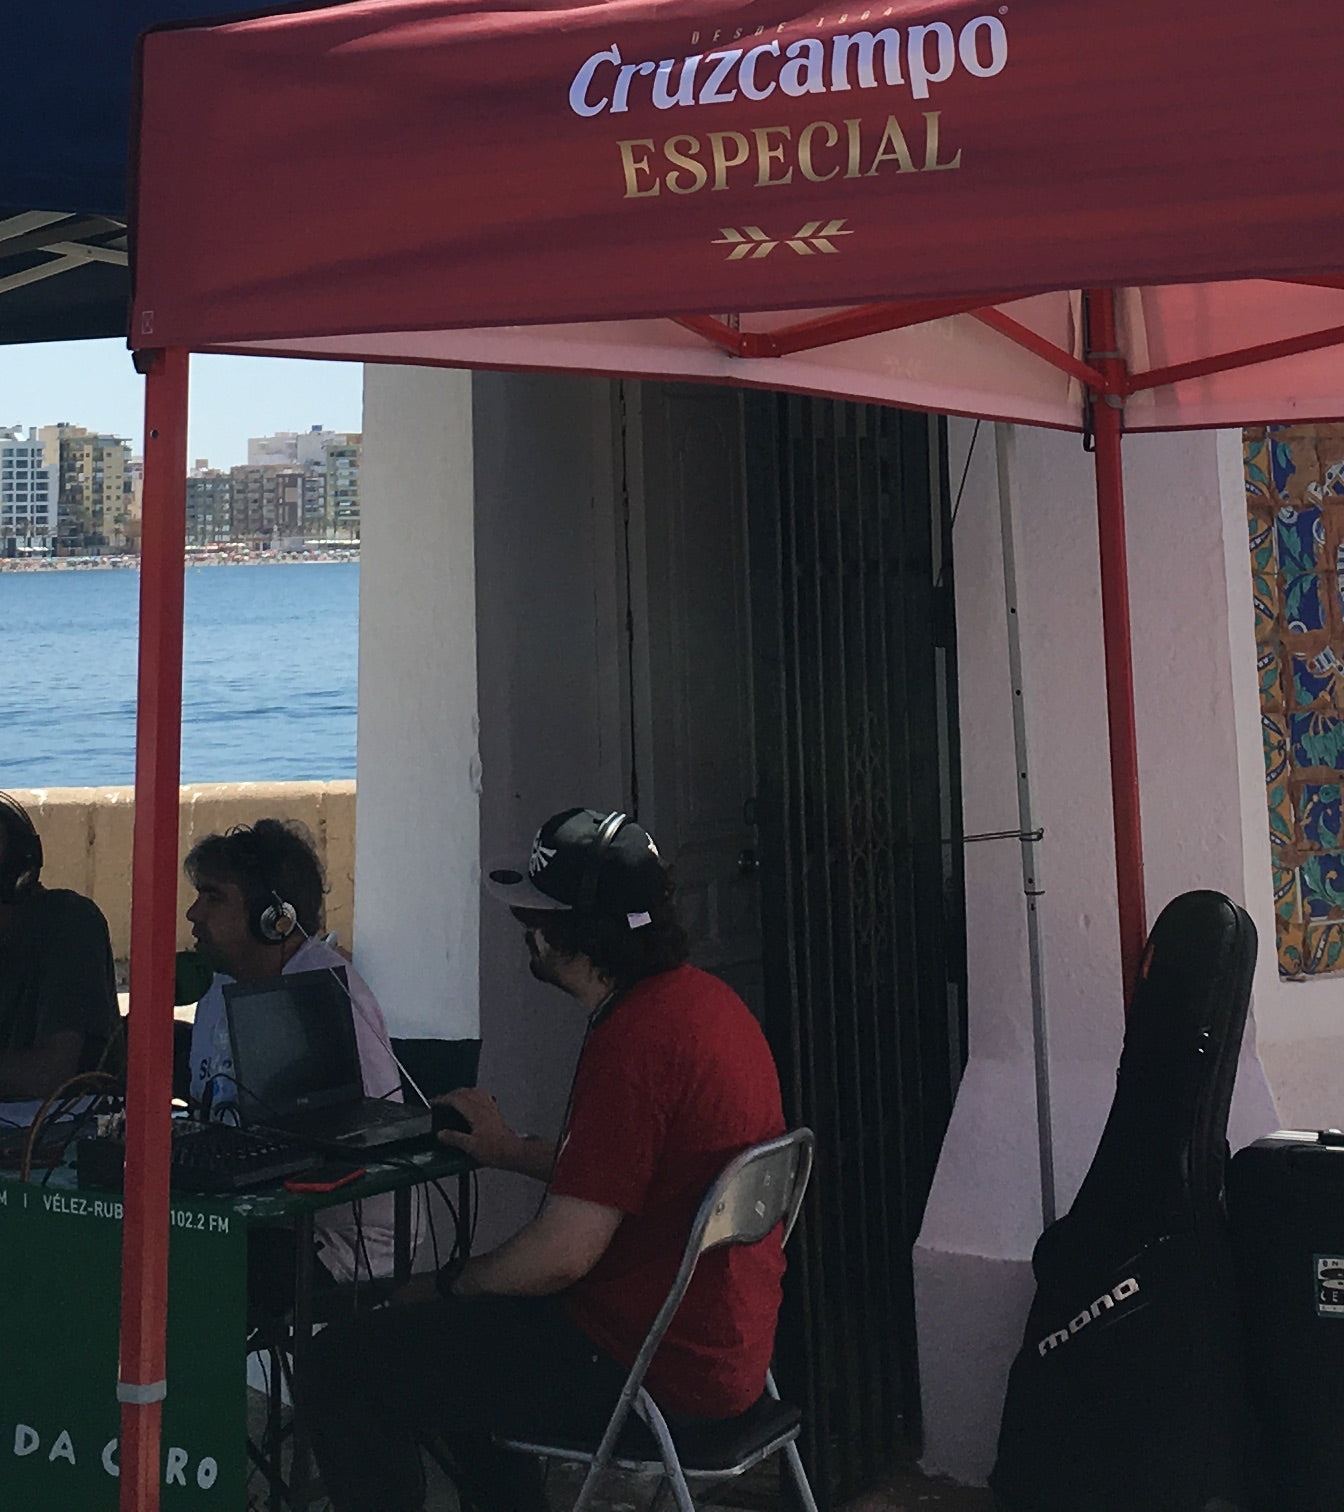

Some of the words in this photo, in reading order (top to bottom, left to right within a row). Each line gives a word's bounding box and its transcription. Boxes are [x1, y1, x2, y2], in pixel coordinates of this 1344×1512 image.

[569, 14, 1008, 117] Cruzcampo
[691, 21, 787, 45] DESDE
[616, 110, 962, 199] ESPECIAL
[170, 1209, 205, 1230] 102.2
[209, 1214, 229, 1234] FM
[1038, 1277, 1140, 1358] mono
[101, 1438, 218, 1490] CRO
